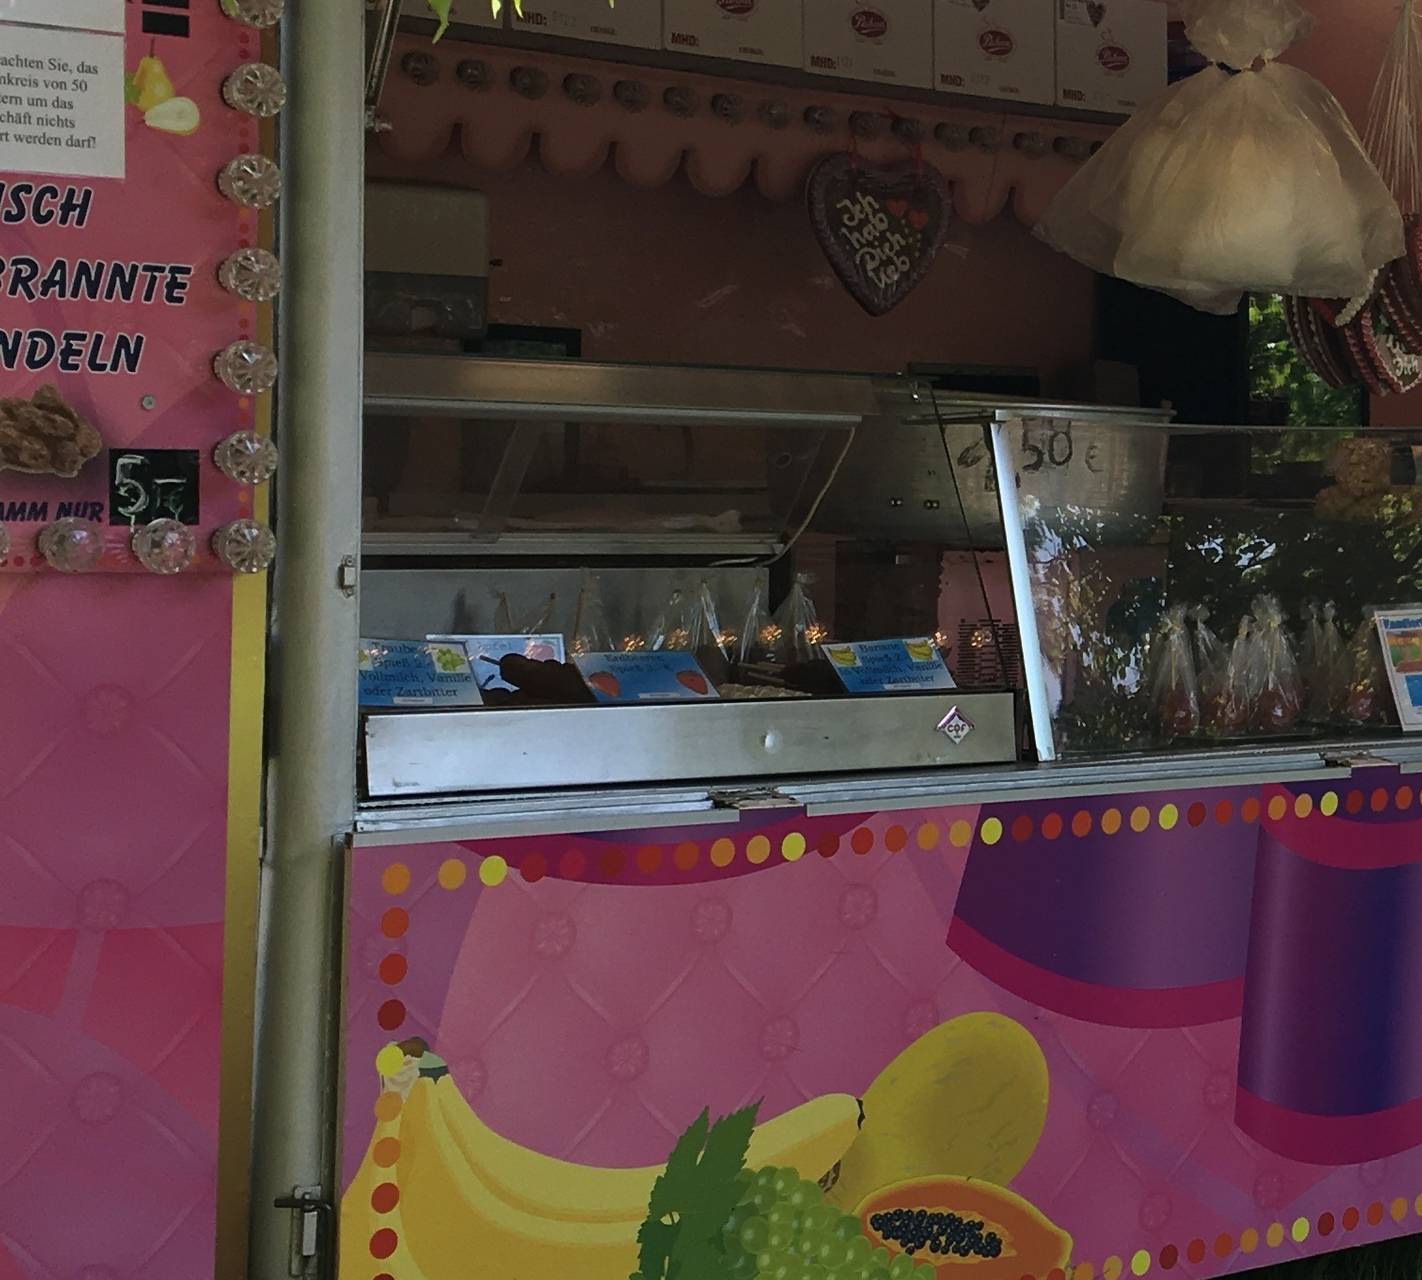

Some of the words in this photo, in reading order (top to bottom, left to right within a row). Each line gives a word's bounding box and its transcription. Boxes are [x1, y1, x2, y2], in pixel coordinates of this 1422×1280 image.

[670, 32, 700, 47] MHD:
[49, 58, 73, 74] Sie,
[76, 60, 99, 75] das
[43, 79, 68, 92] von
[71, 80, 88, 93] 50
[0, 94, 23, 106] ern
[27, 96, 48, 108] um
[51, 96, 74, 110] das
[36, 114, 76, 129] nichts
[13, 131, 62, 147] werden
[0, 182, 93, 228] SCH
[0, 501, 48, 522] MM
[363, 686, 393, 697] oder
[395, 685, 459, 698] Zartbitter
